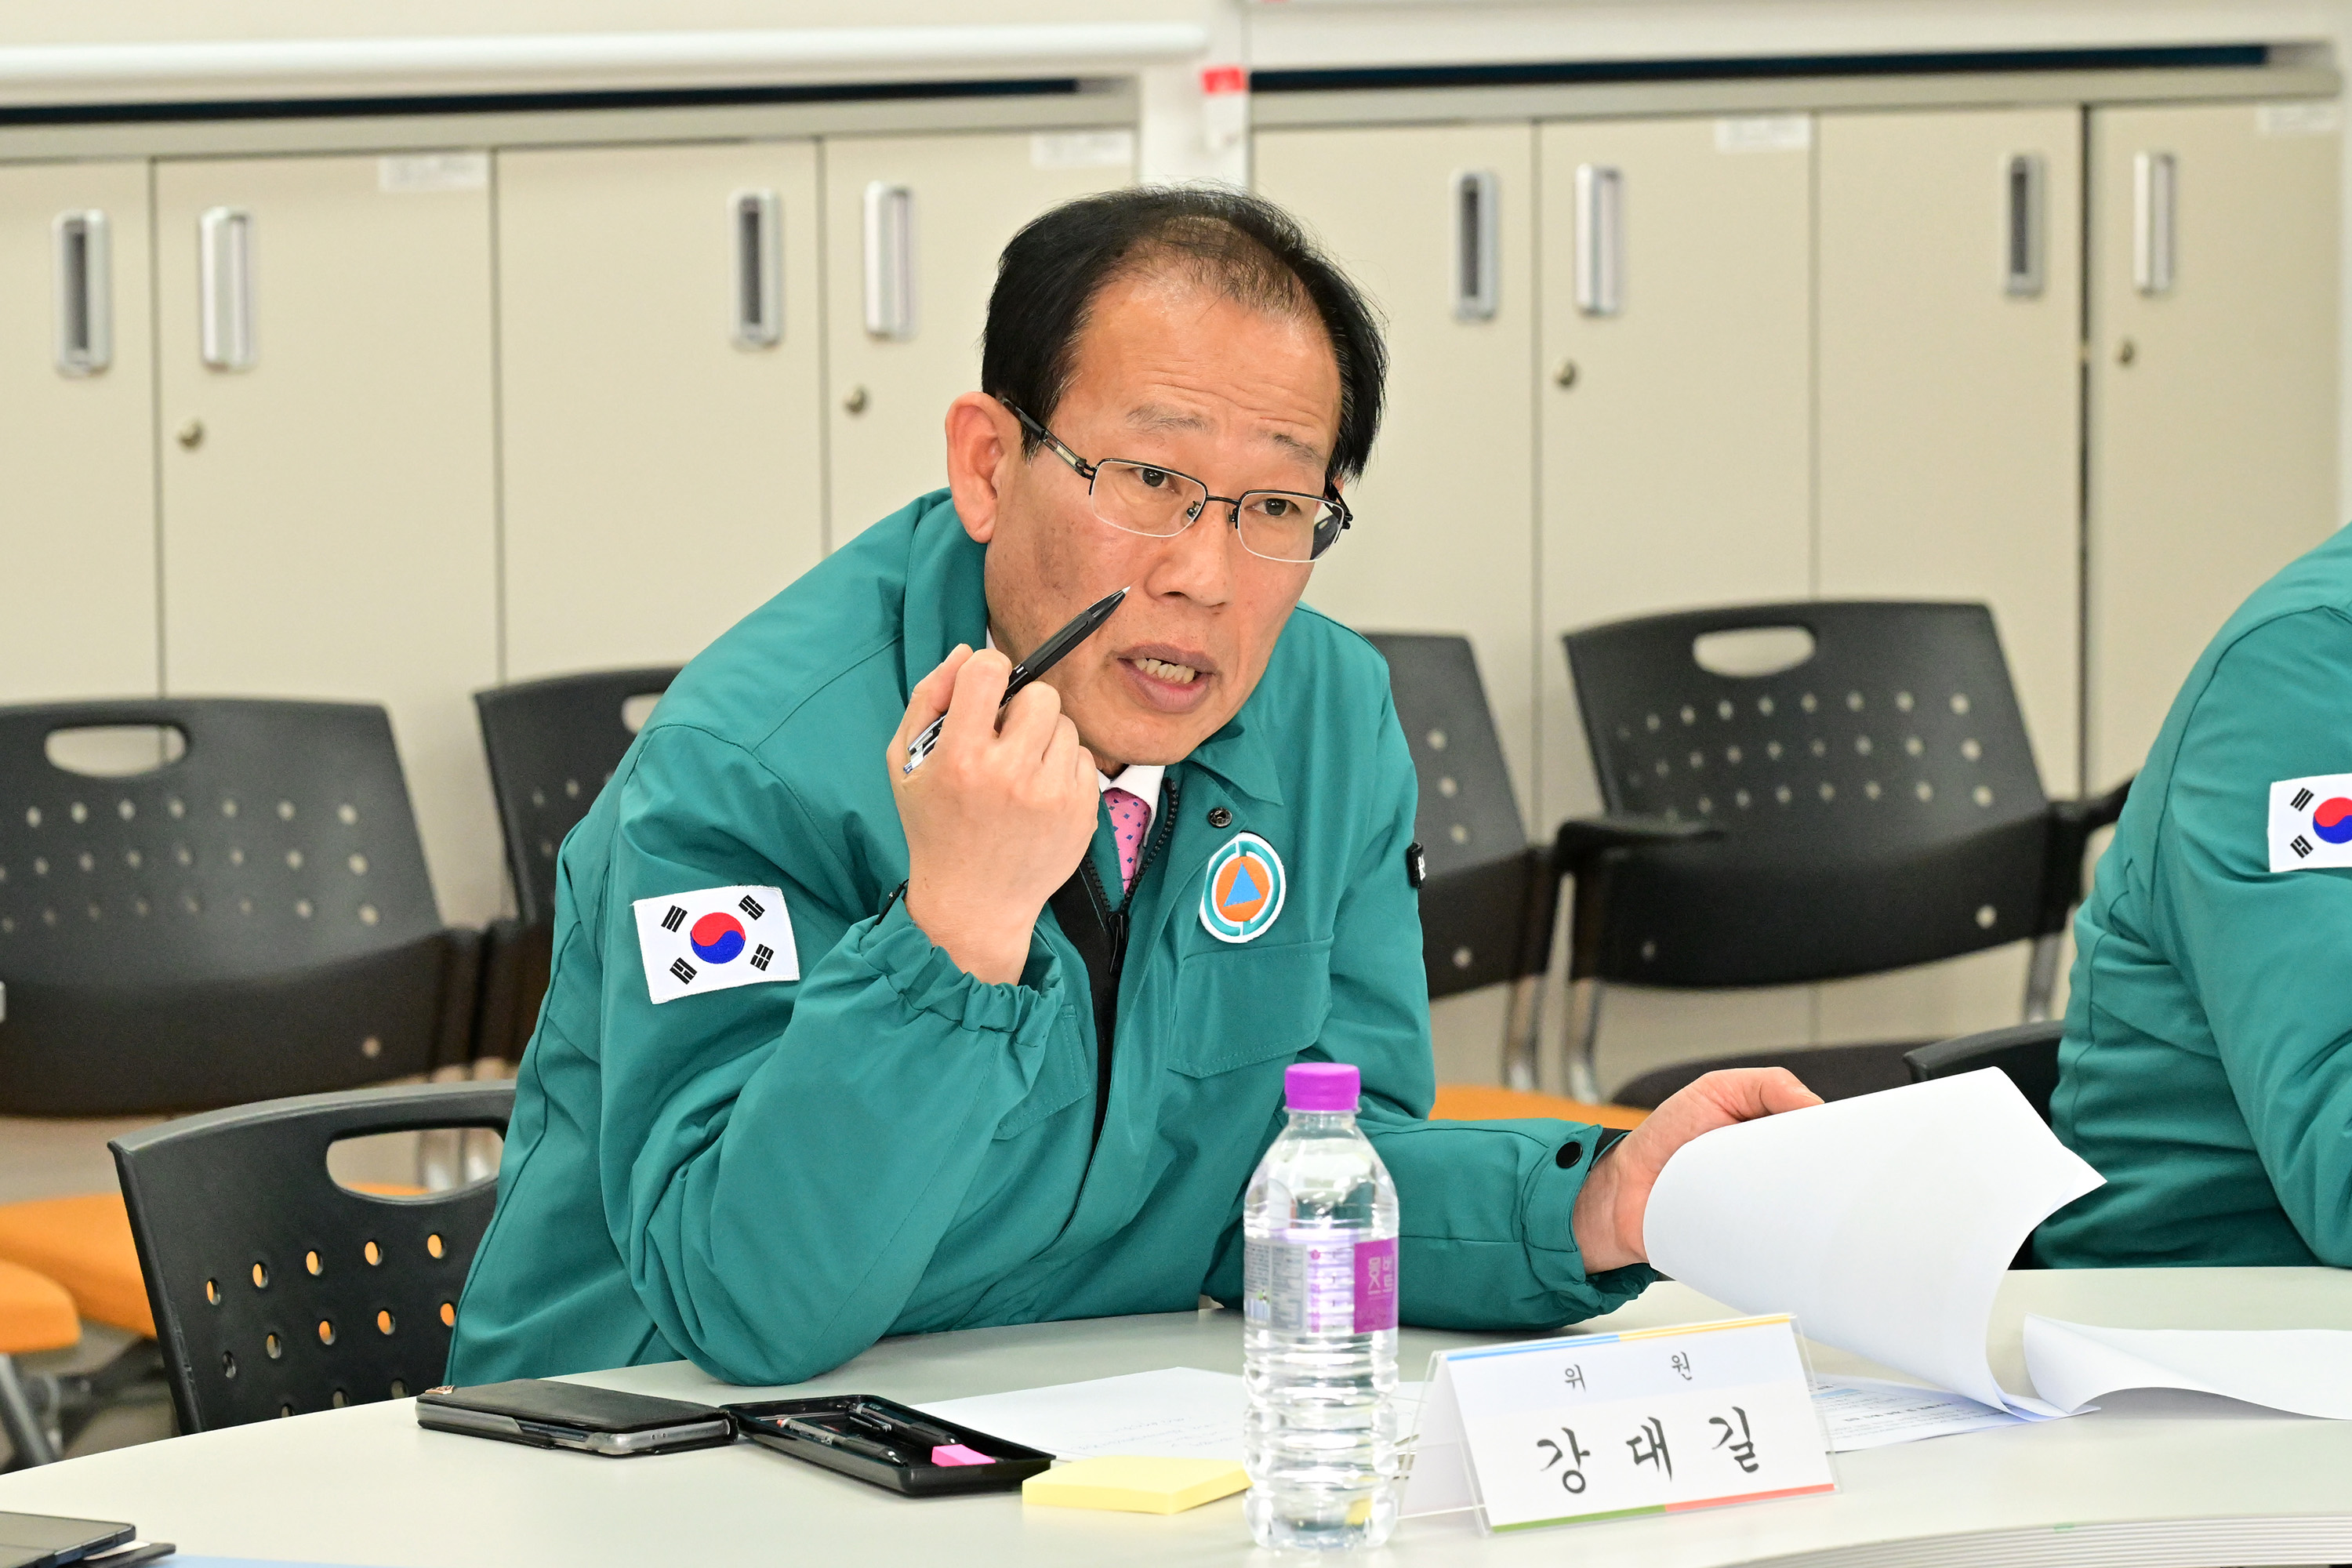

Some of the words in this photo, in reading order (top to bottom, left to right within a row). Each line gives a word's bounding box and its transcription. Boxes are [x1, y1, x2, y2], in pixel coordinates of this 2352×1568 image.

[1564, 1364, 1586, 1392] 위
[1671, 1351, 1693, 1381] 원
[1536, 1426, 1592, 1494] 강
[1625, 1416, 1673, 1482] 대
[1708, 1406, 1760, 1474] 길
